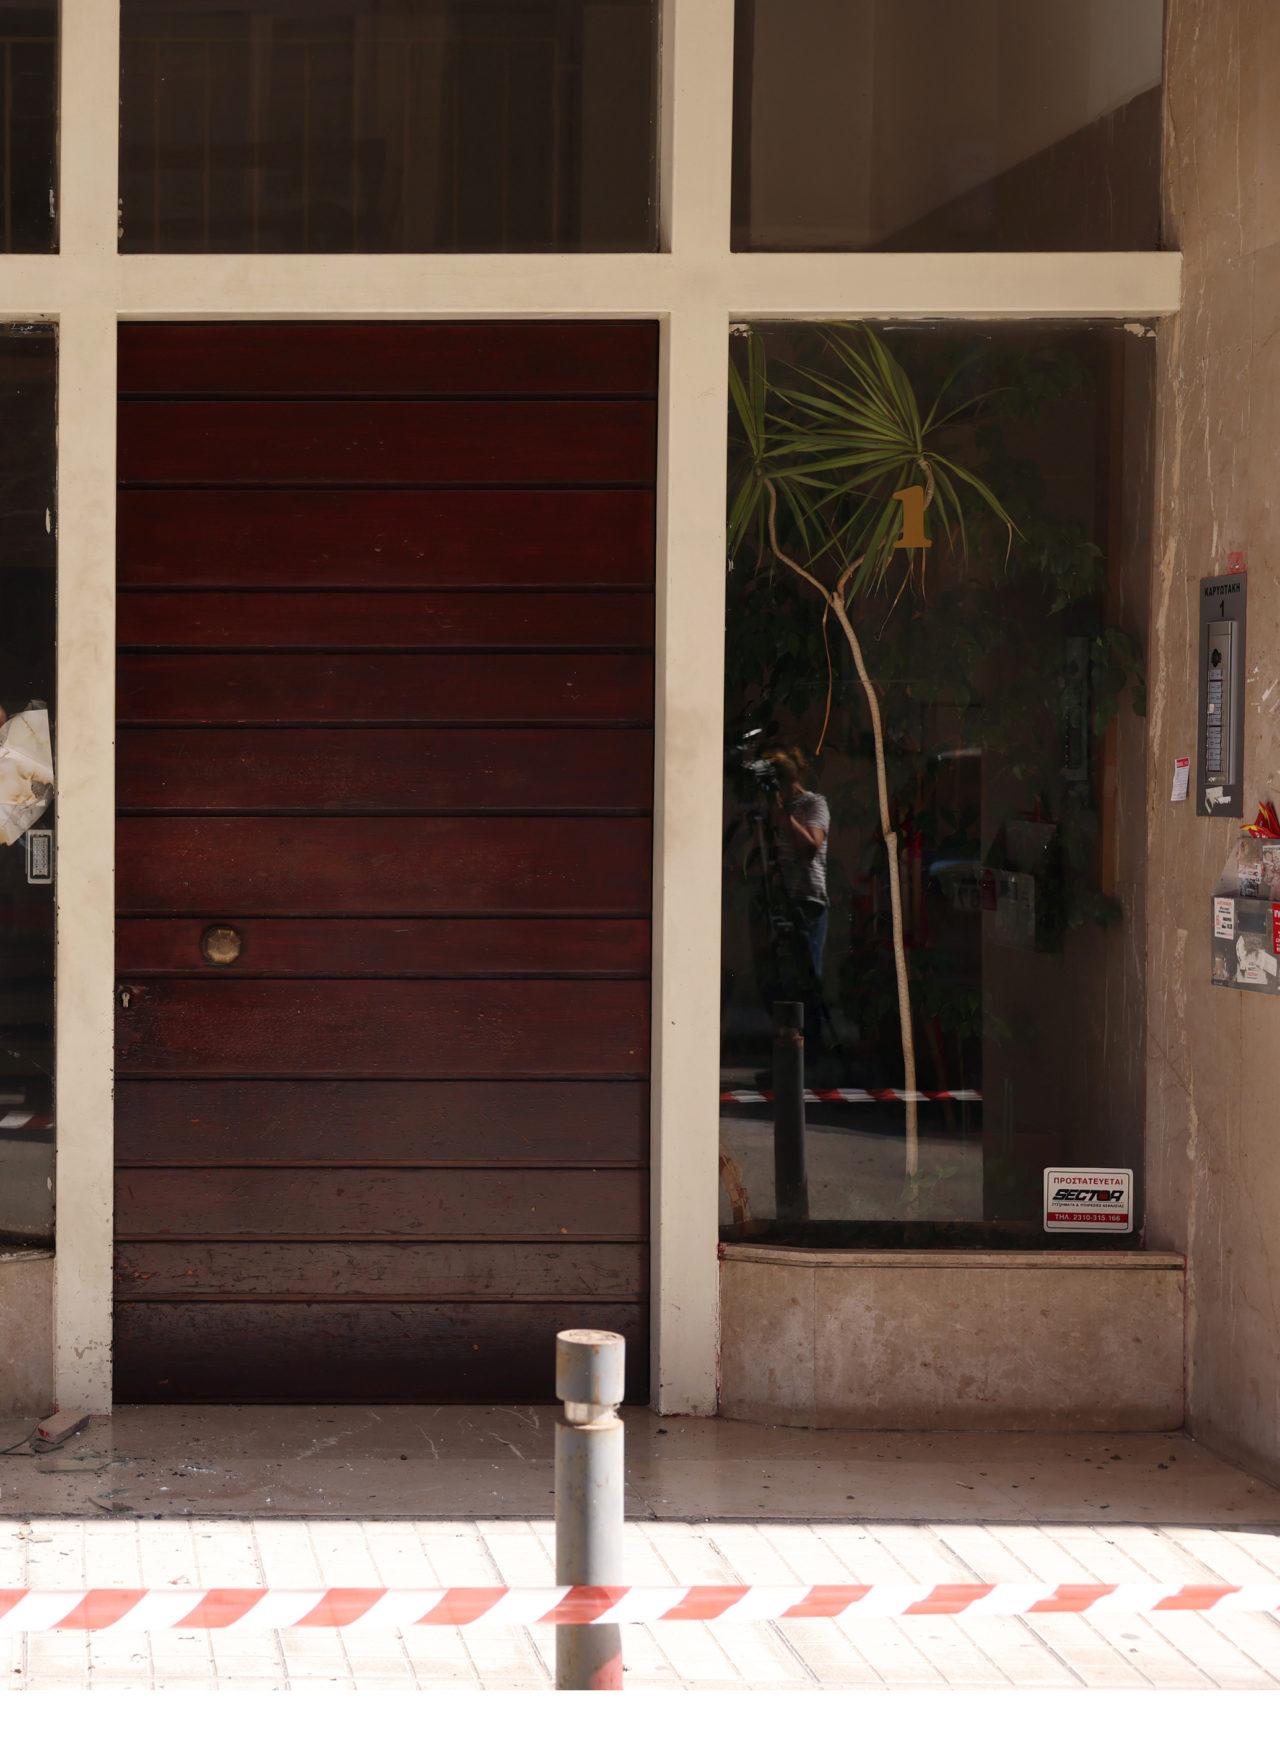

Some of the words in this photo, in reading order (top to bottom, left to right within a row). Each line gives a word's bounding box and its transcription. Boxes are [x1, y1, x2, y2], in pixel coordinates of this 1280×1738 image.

[892, 485, 933, 549] 1
[1204, 582, 1241, 596] ΚΑΡΥΩΤΑΚΗ
[1219, 600, 1226, 618] 1
[1053, 1177, 1123, 1185] ΠΡΟΣΤΑΤΕΥΕΤΑΙ
[1052, 1189, 1124, 1201] SECTOR
[1055, 1213, 1071, 1221] ΤΗΛ.
